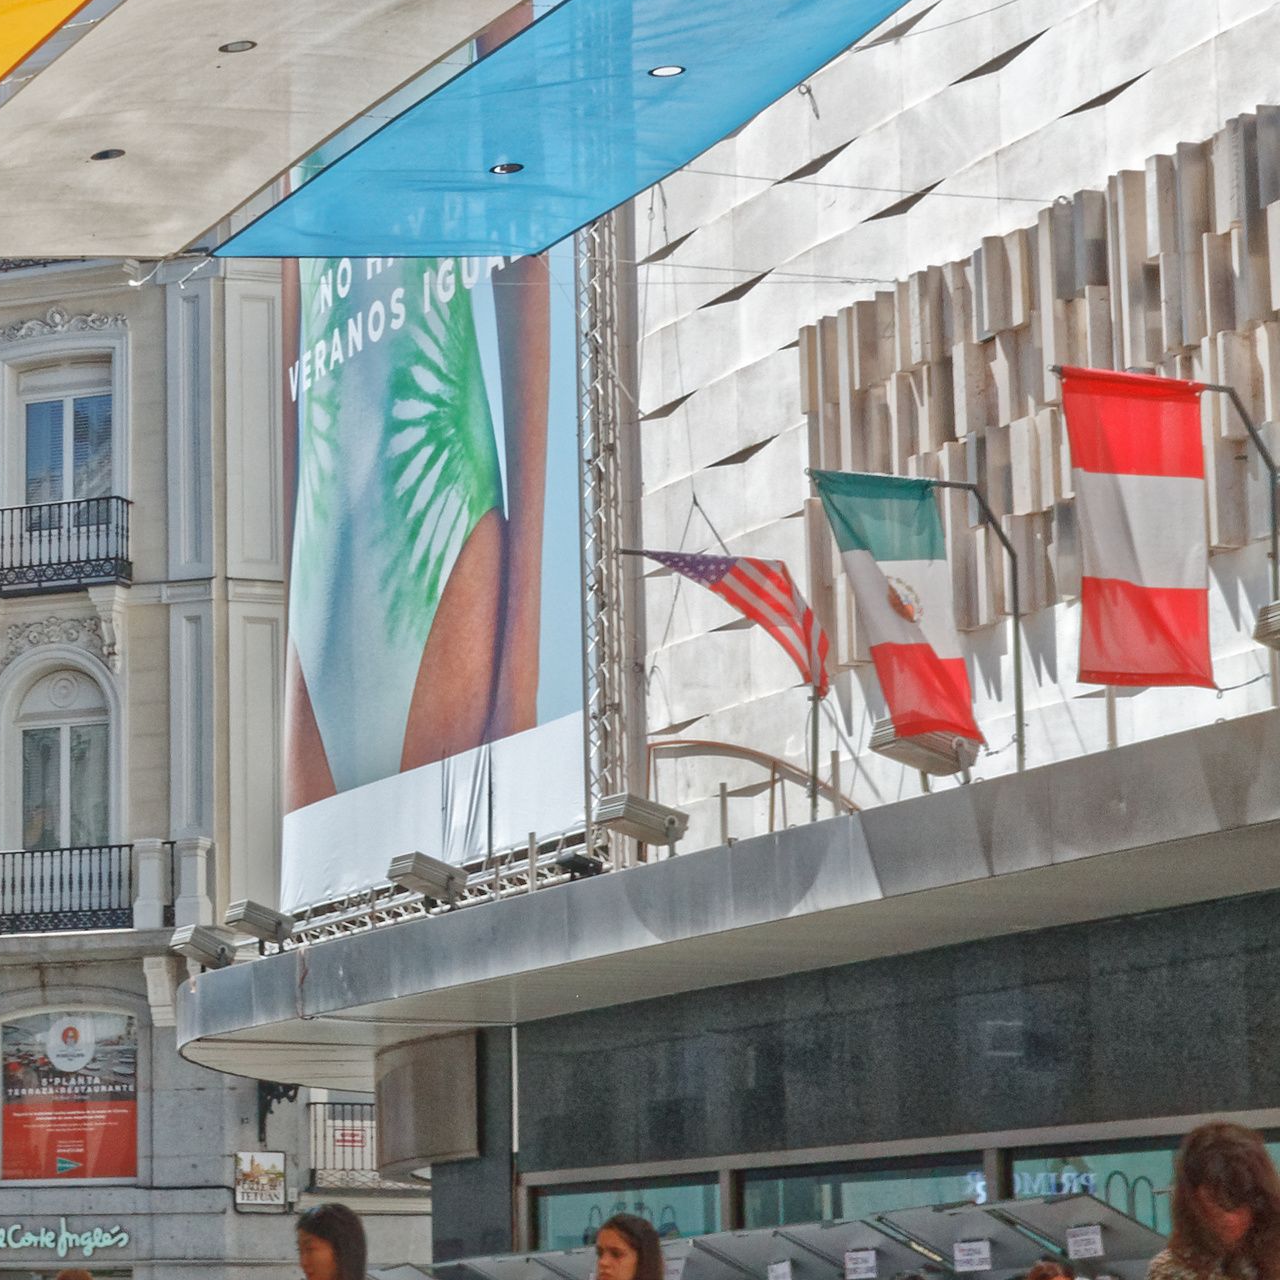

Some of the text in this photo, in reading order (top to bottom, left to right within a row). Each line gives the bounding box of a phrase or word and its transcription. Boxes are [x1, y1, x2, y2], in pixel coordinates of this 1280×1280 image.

[320, 257, 352, 314] NO
[288, 287, 407, 402] VERANOS
[7, 1224, 56, 1249] Corte
[57, 1217, 130, 1258] Inglés
